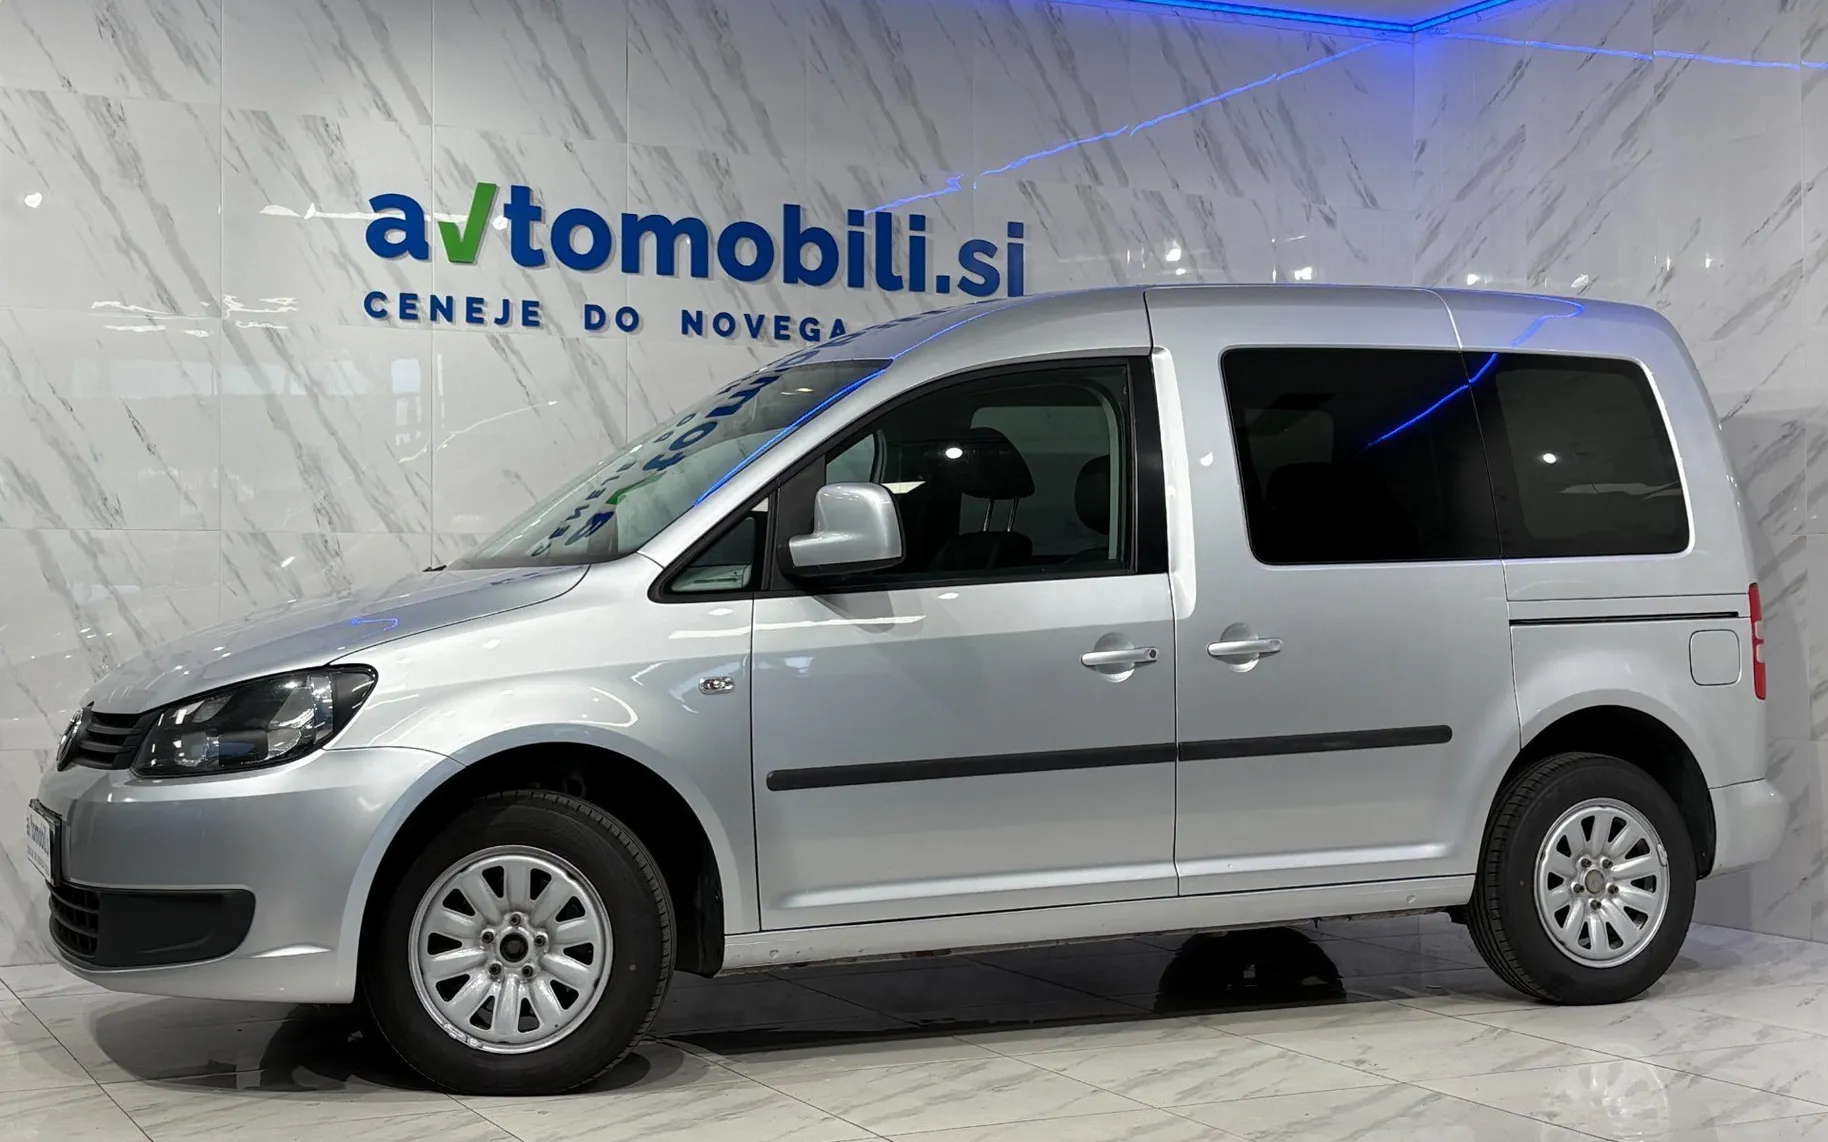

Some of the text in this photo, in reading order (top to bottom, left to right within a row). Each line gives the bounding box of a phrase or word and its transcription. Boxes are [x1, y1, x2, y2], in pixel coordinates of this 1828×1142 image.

[366, 182, 1025, 298] avtomobili.si
[363, 290, 847, 342] CENEJE DO NOVEGA
